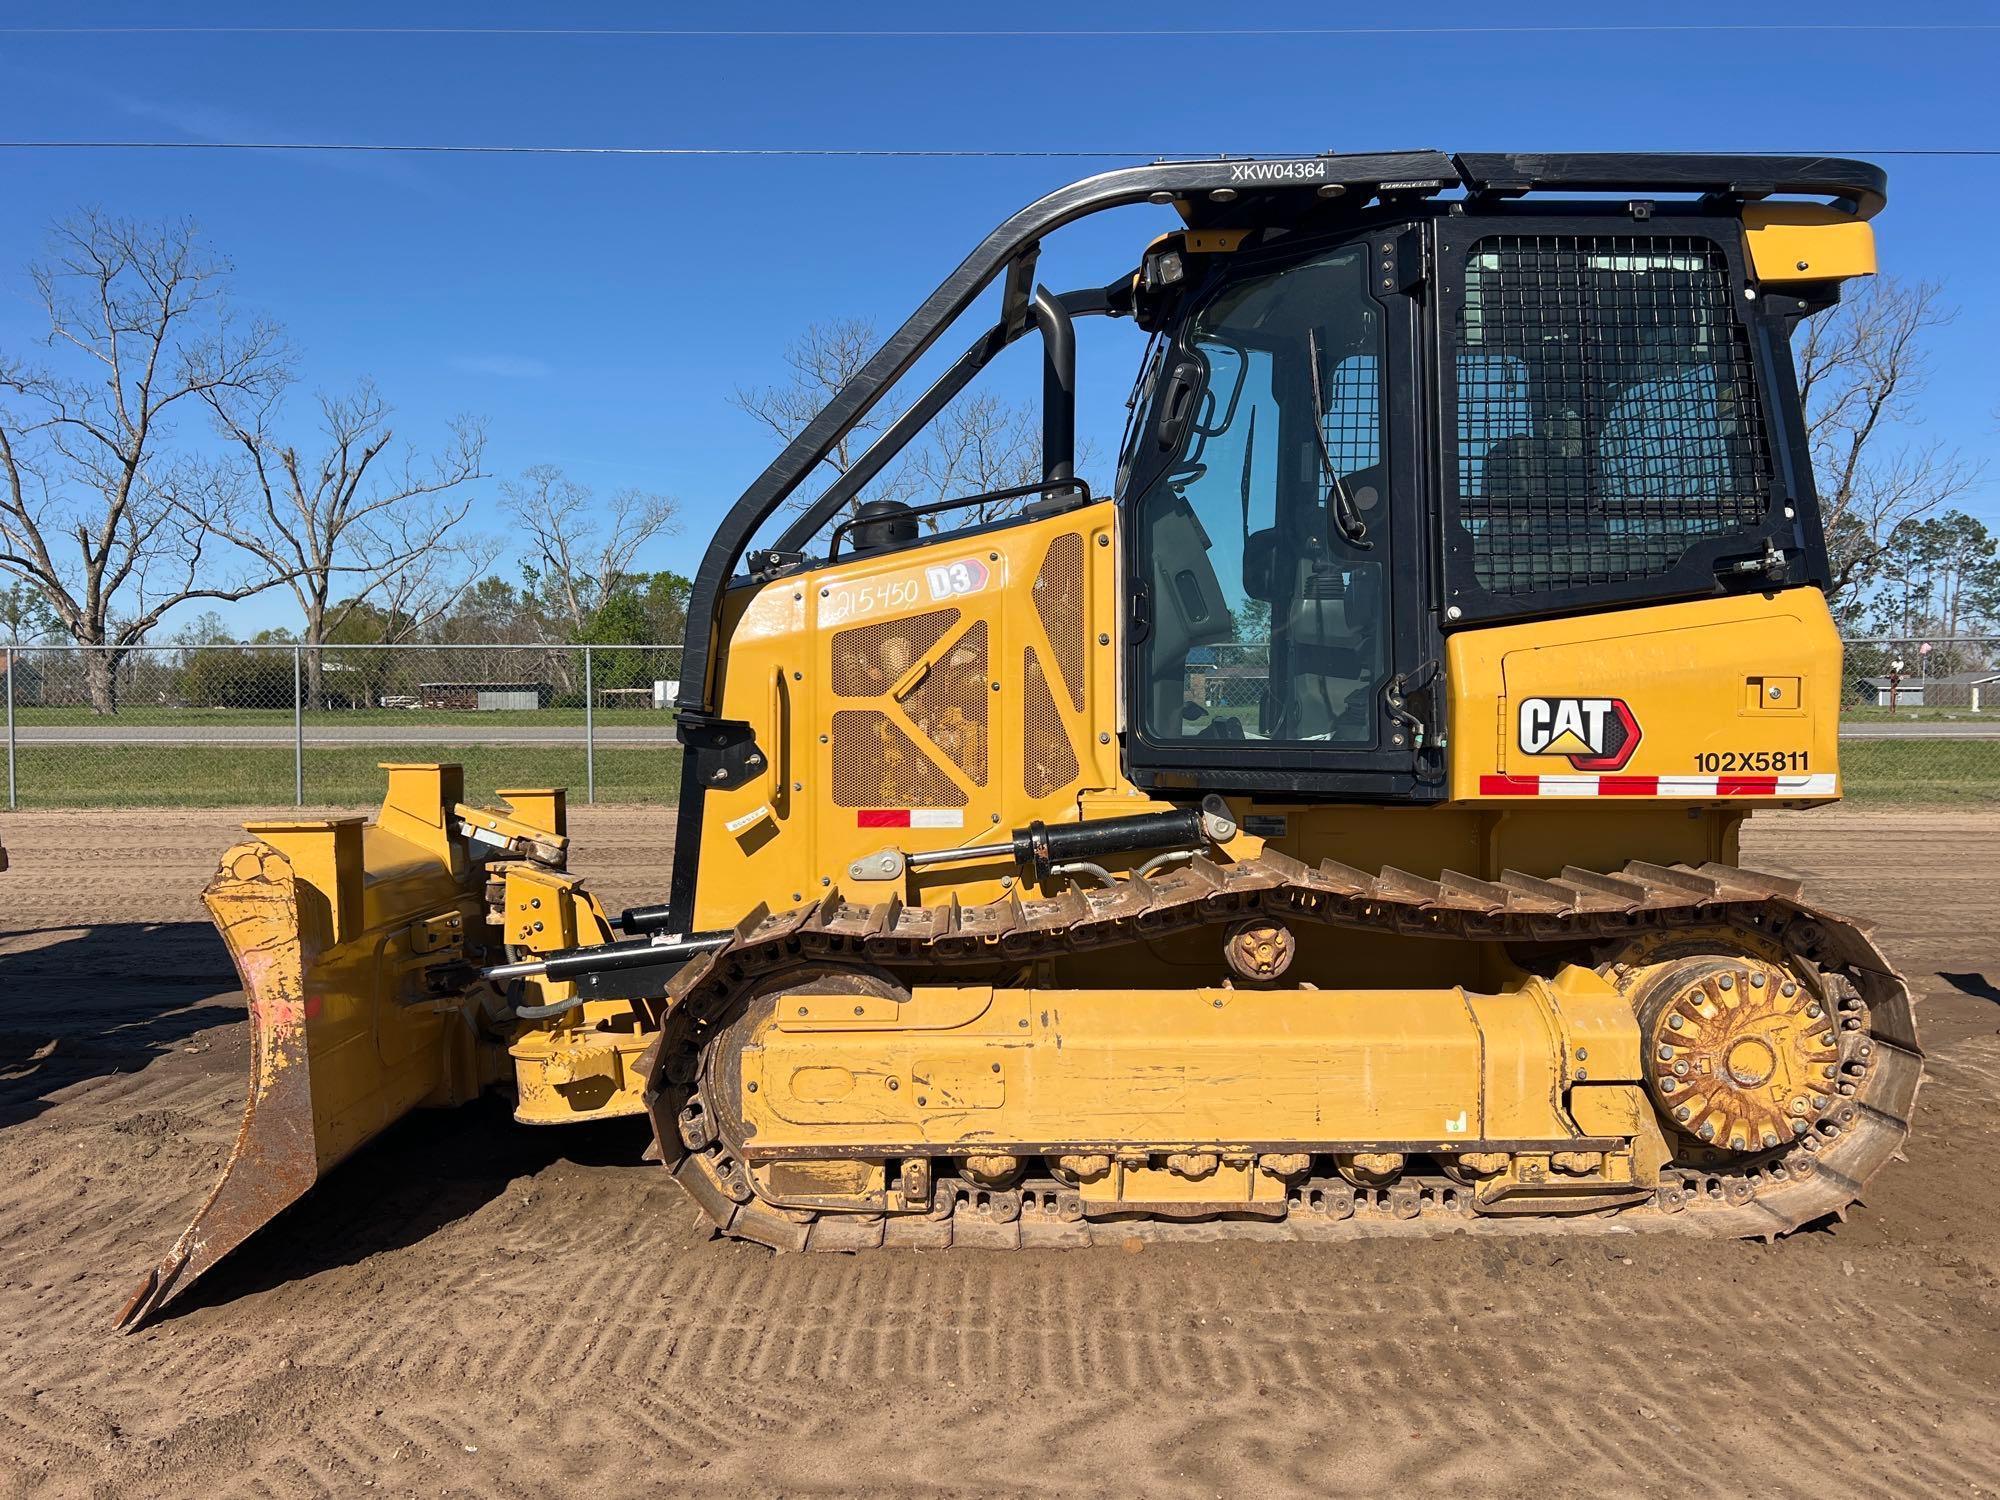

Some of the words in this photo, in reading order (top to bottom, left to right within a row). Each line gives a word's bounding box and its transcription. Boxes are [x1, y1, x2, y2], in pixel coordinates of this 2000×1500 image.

[1231, 163, 1325, 180] XKW04364
[926, 562, 971, 599] D3
[1519, 699, 1611, 753] CAT
[1694, 751, 1809, 773] 102X5811
